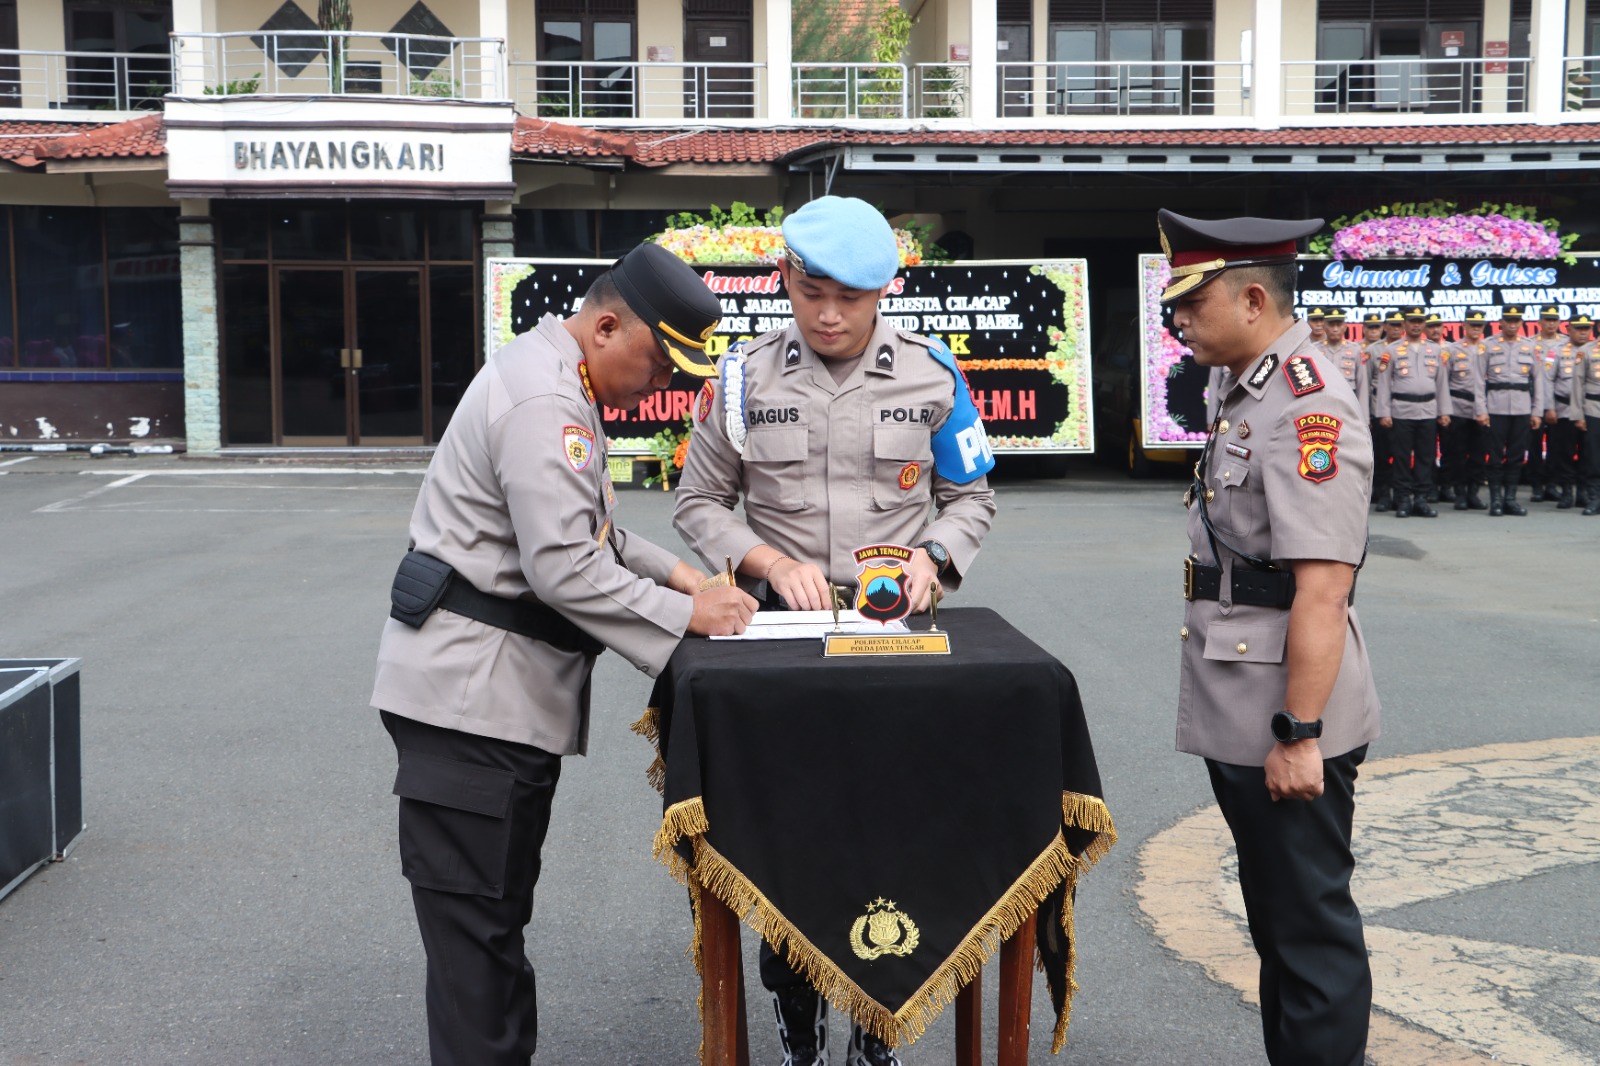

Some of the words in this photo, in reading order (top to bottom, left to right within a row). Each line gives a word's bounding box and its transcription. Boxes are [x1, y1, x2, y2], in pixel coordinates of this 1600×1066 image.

[233, 141, 444, 171] BHAYANGKARI
[1323, 261, 1430, 288] Selamat
[1441, 263, 1461, 286] &
[1470, 260, 1557, 287] Sukses
[703, 271, 780, 294] lamat
[877, 297, 942, 312] OLRESTA
[946, 296, 1010, 311] CILACAP
[1302, 290, 1357, 305] SERAH
[1361, 290, 1426, 305] TERIMA
[1430, 289, 1493, 305] JABATAN
[922, 314, 971, 330] POLDA
[975, 314, 1023, 330] BABEL
[750, 407, 799, 425] BAGUS
[880, 408, 935, 423] POLRI
[1300, 416, 1337, 428] POLDA
[858, 549, 878, 560] JAWA
[879, 547, 909, 559] TENGAH
